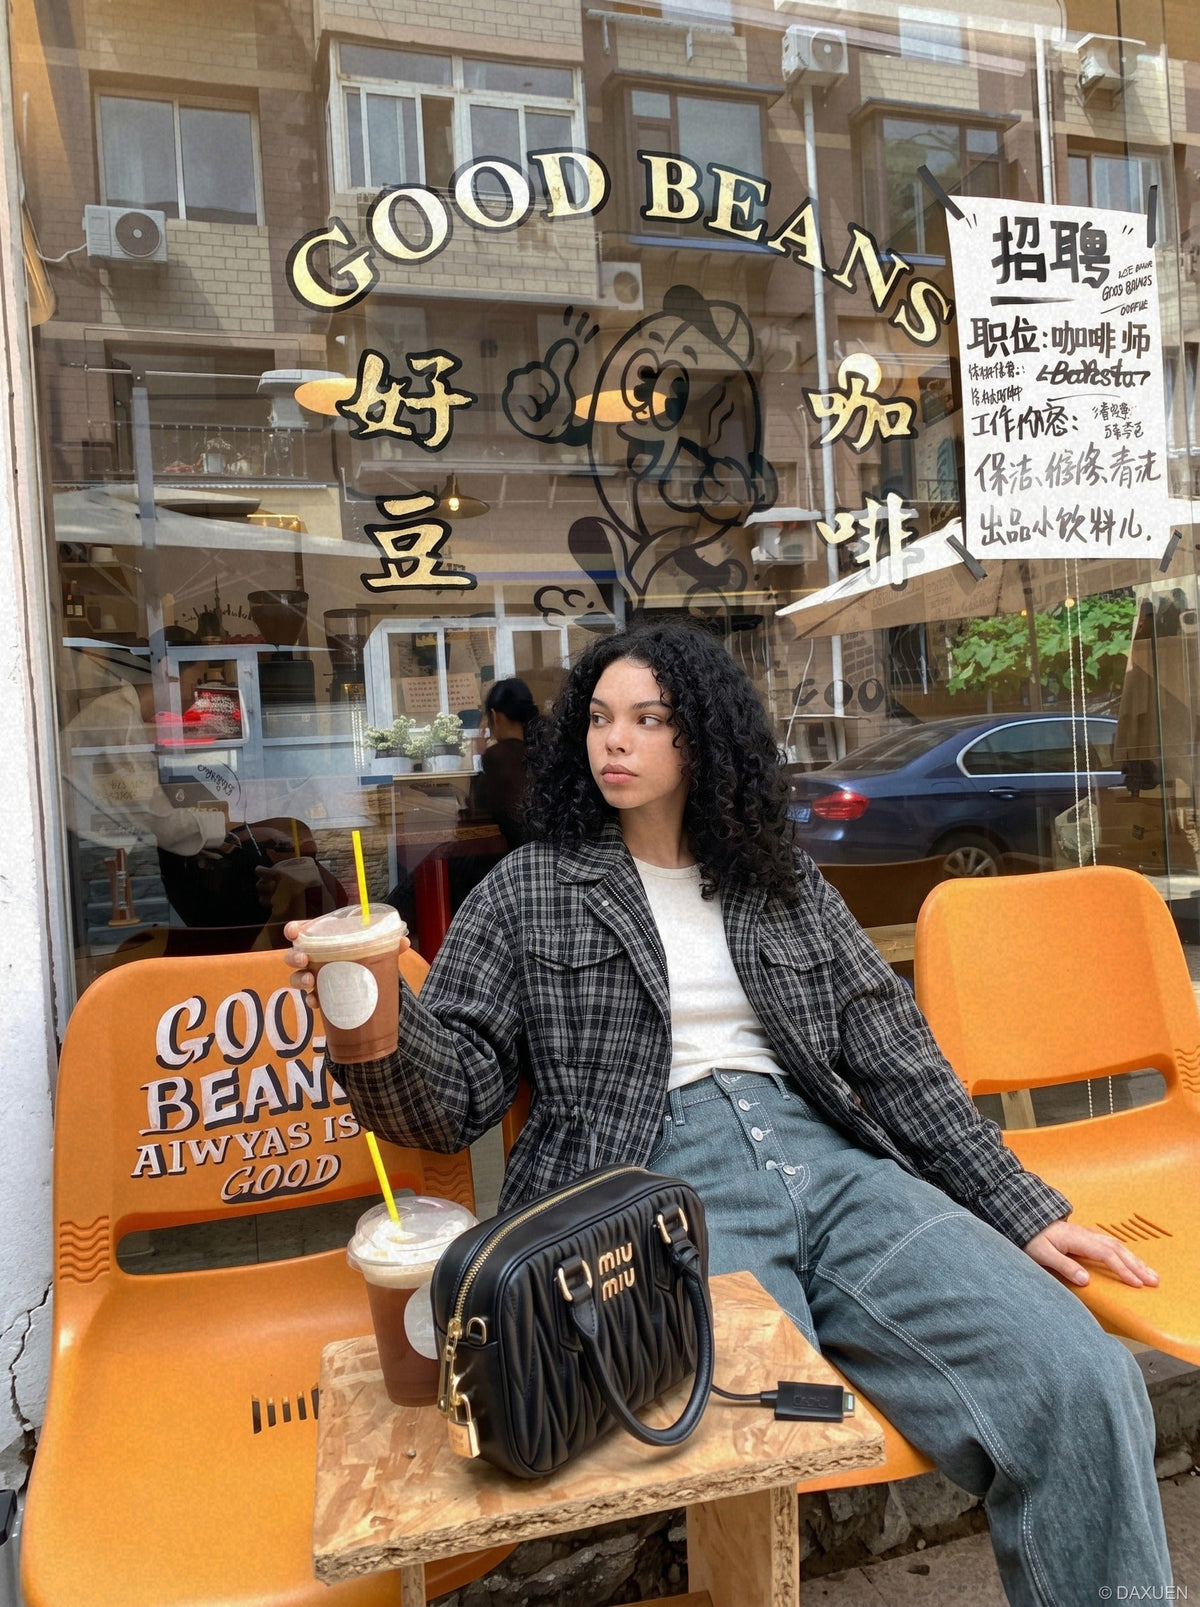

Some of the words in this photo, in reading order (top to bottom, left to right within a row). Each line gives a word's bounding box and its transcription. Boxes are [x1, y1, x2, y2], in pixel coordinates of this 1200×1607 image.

[287, 148, 611, 312] GOOD
[637, 149, 957, 346] BEANS
[991, 216, 1111, 289] 招聘
[323, 1112, 363, 1143] IS
[220, 1153, 342, 1204] GOOD
